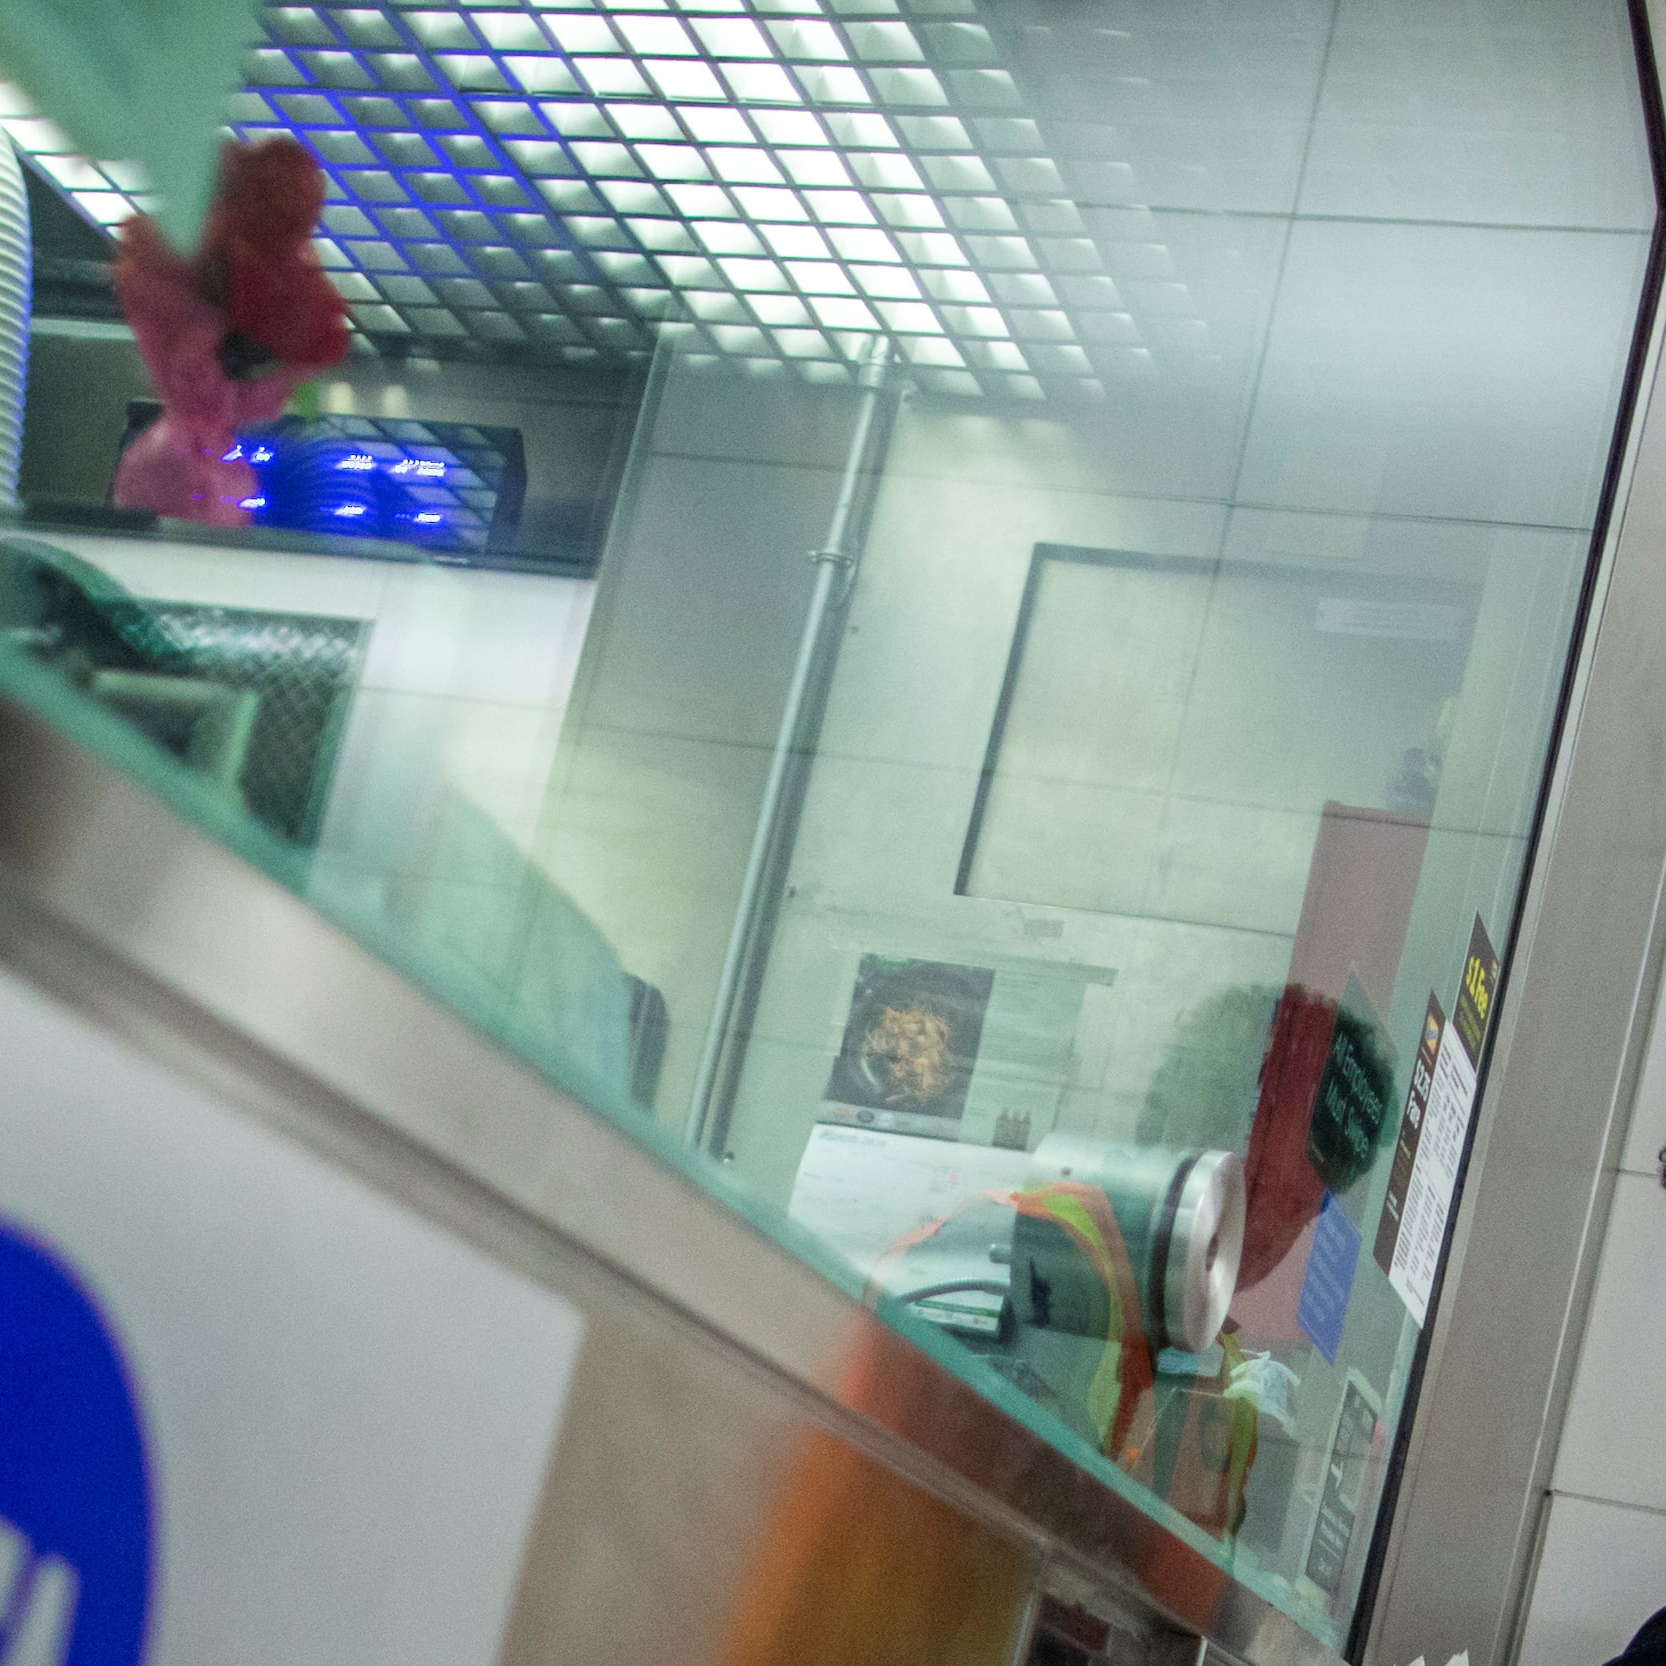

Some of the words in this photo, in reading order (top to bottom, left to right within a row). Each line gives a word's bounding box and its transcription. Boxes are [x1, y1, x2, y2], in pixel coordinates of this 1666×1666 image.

[1466, 956, 1481, 996] $1
[1474, 967, 1488, 1020] Fee
[1326, 1077, 1347, 1123] Must
[1342, 1044, 1382, 1125] Employees
